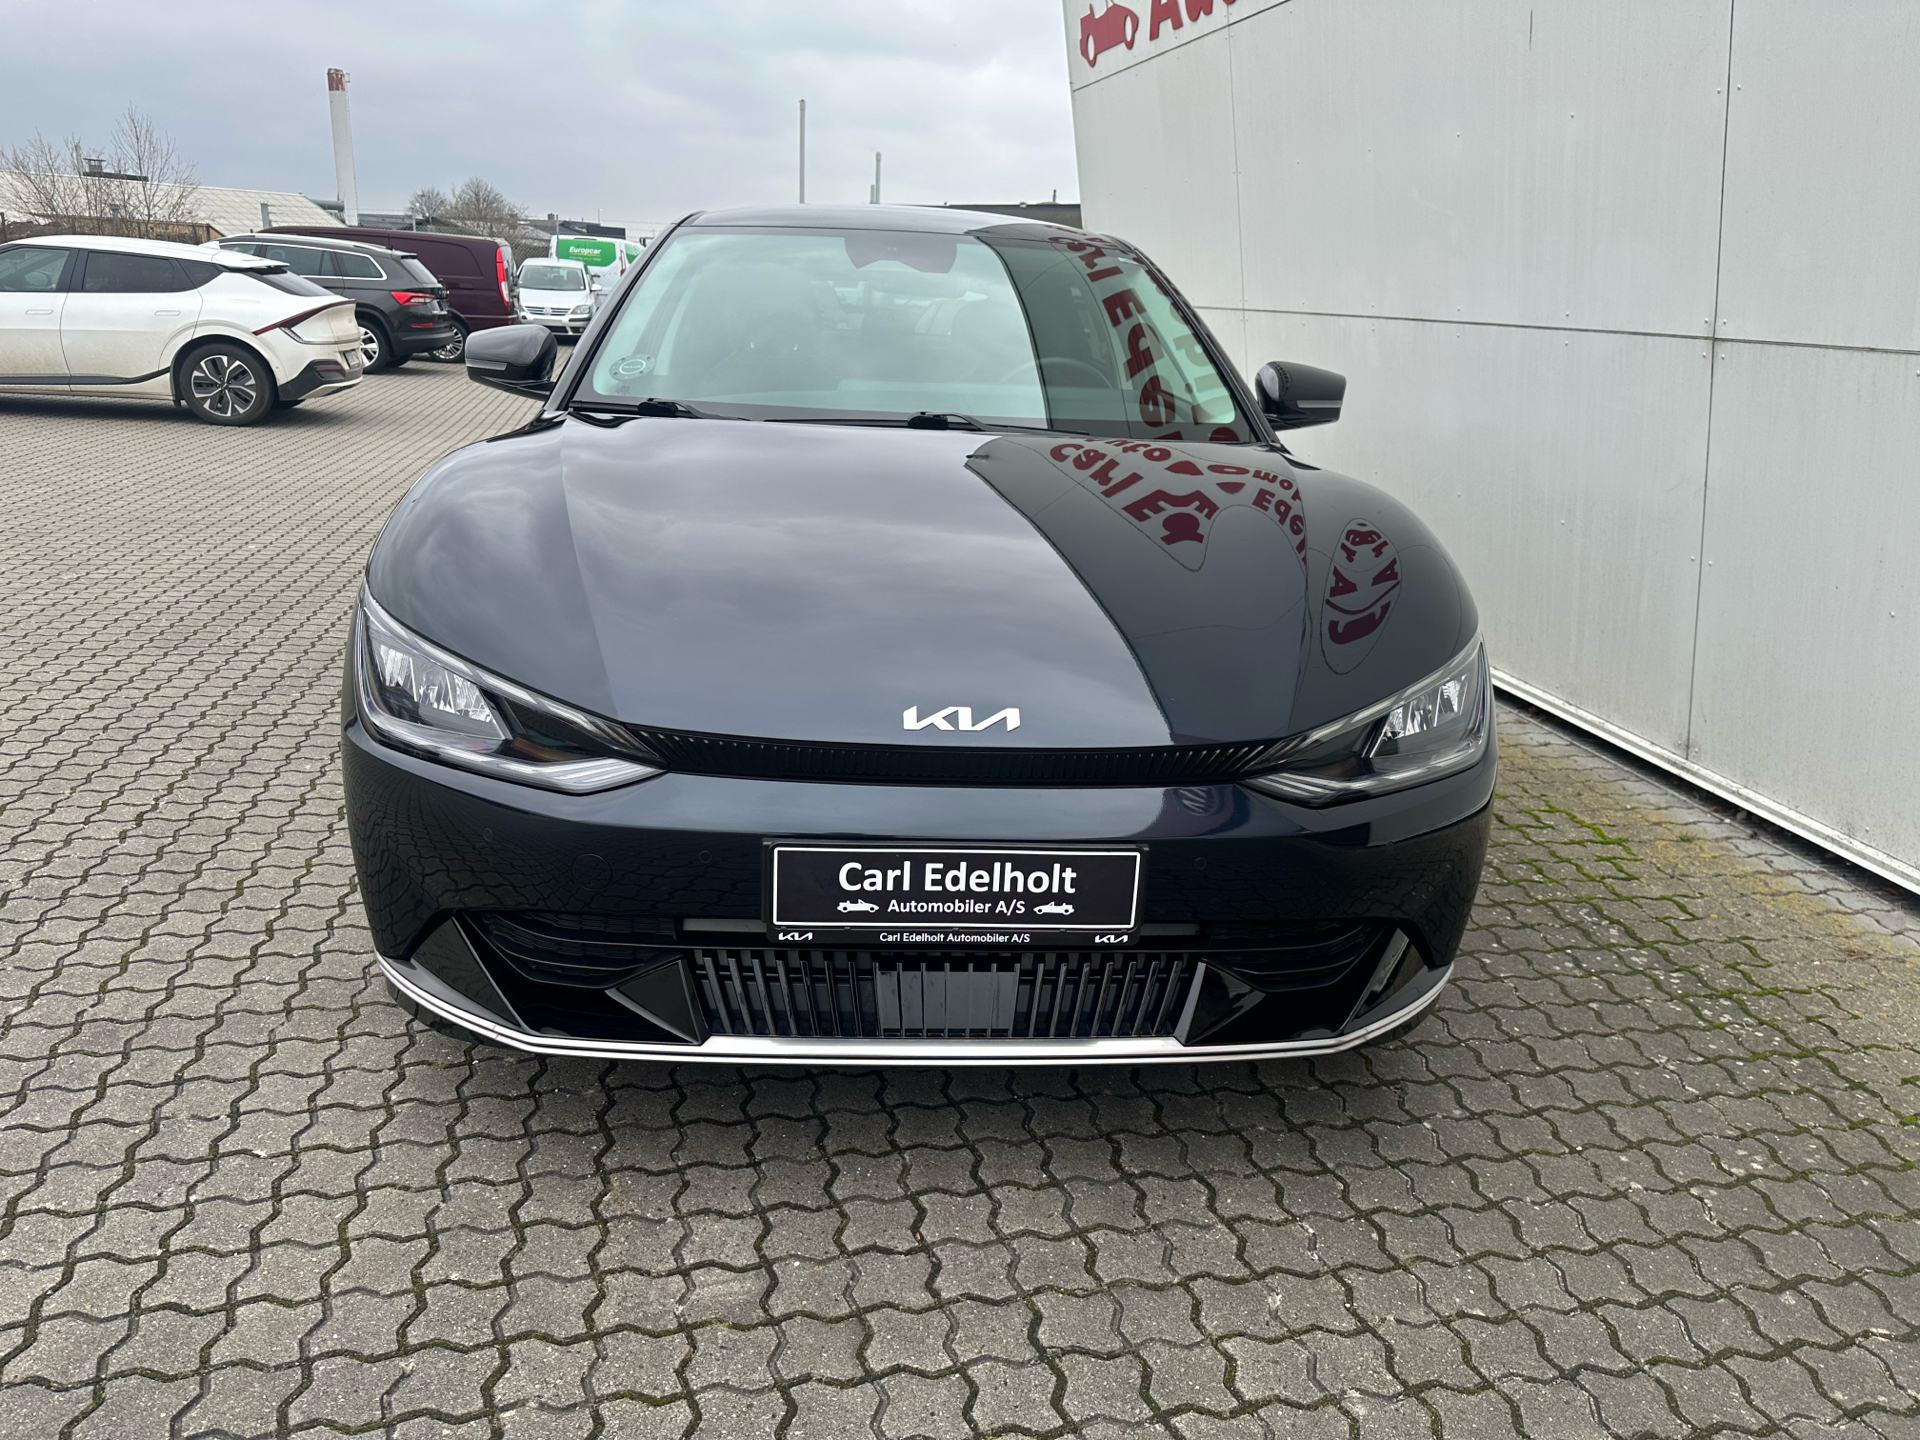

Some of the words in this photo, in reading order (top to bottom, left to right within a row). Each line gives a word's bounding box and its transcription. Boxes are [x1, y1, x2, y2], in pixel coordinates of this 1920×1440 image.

[569, 246, 602, 255] Europcar
[903, 705, 1021, 732] KIA
[839, 861, 911, 891] Carl
[924, 861, 1077, 894] Edelholt
[887, 899, 992, 913] Automobiler
[995, 899, 1026, 916] A/S
[880, 932, 900, 942] Carl
[903, 932, 945, 942] Edelholt
[946, 933, 1010, 943] Automobiler
[1011, 933, 1031, 943] A/S
